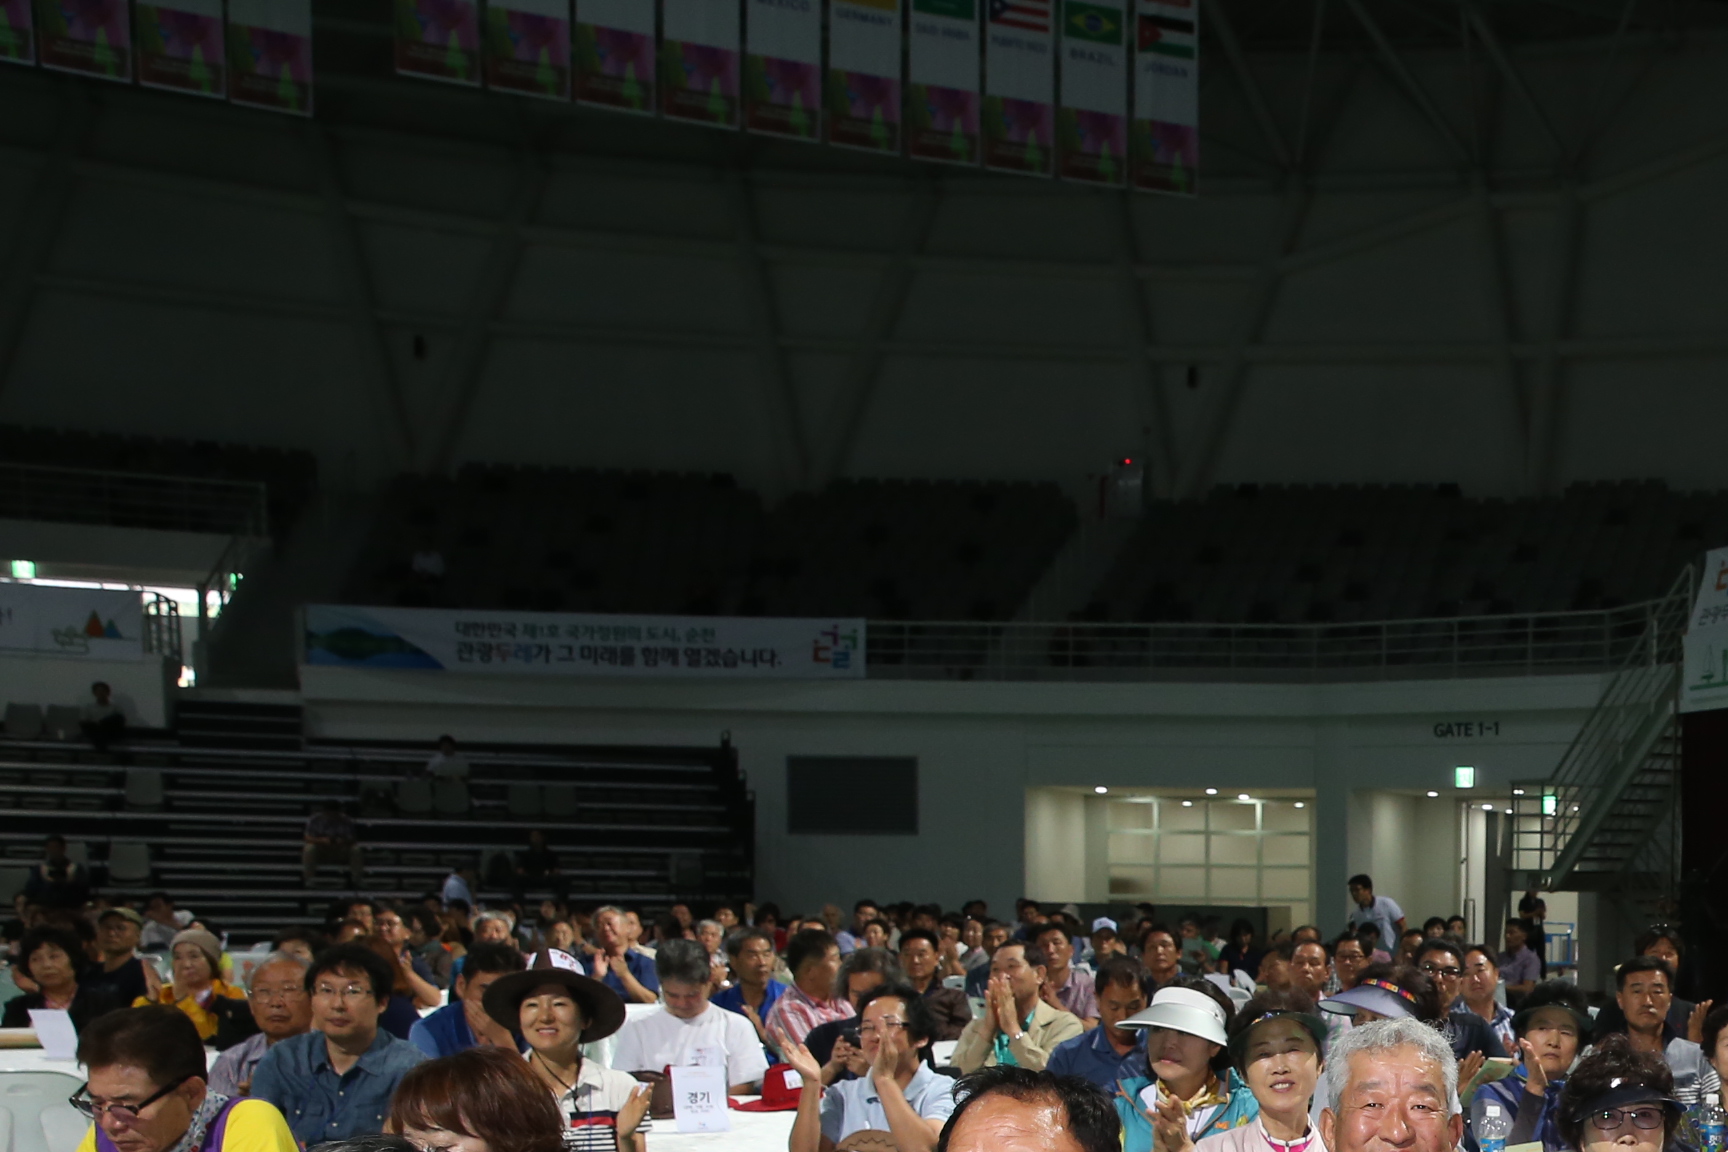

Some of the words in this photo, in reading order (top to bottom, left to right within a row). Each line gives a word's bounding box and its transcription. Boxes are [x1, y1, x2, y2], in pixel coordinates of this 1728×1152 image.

[580, 645, 636, 667] 미래를
[1433, 721, 1474, 738] GATE
[1478, 721, 1500, 737] 1-1
[687, 1091, 711, 1105] 경기
